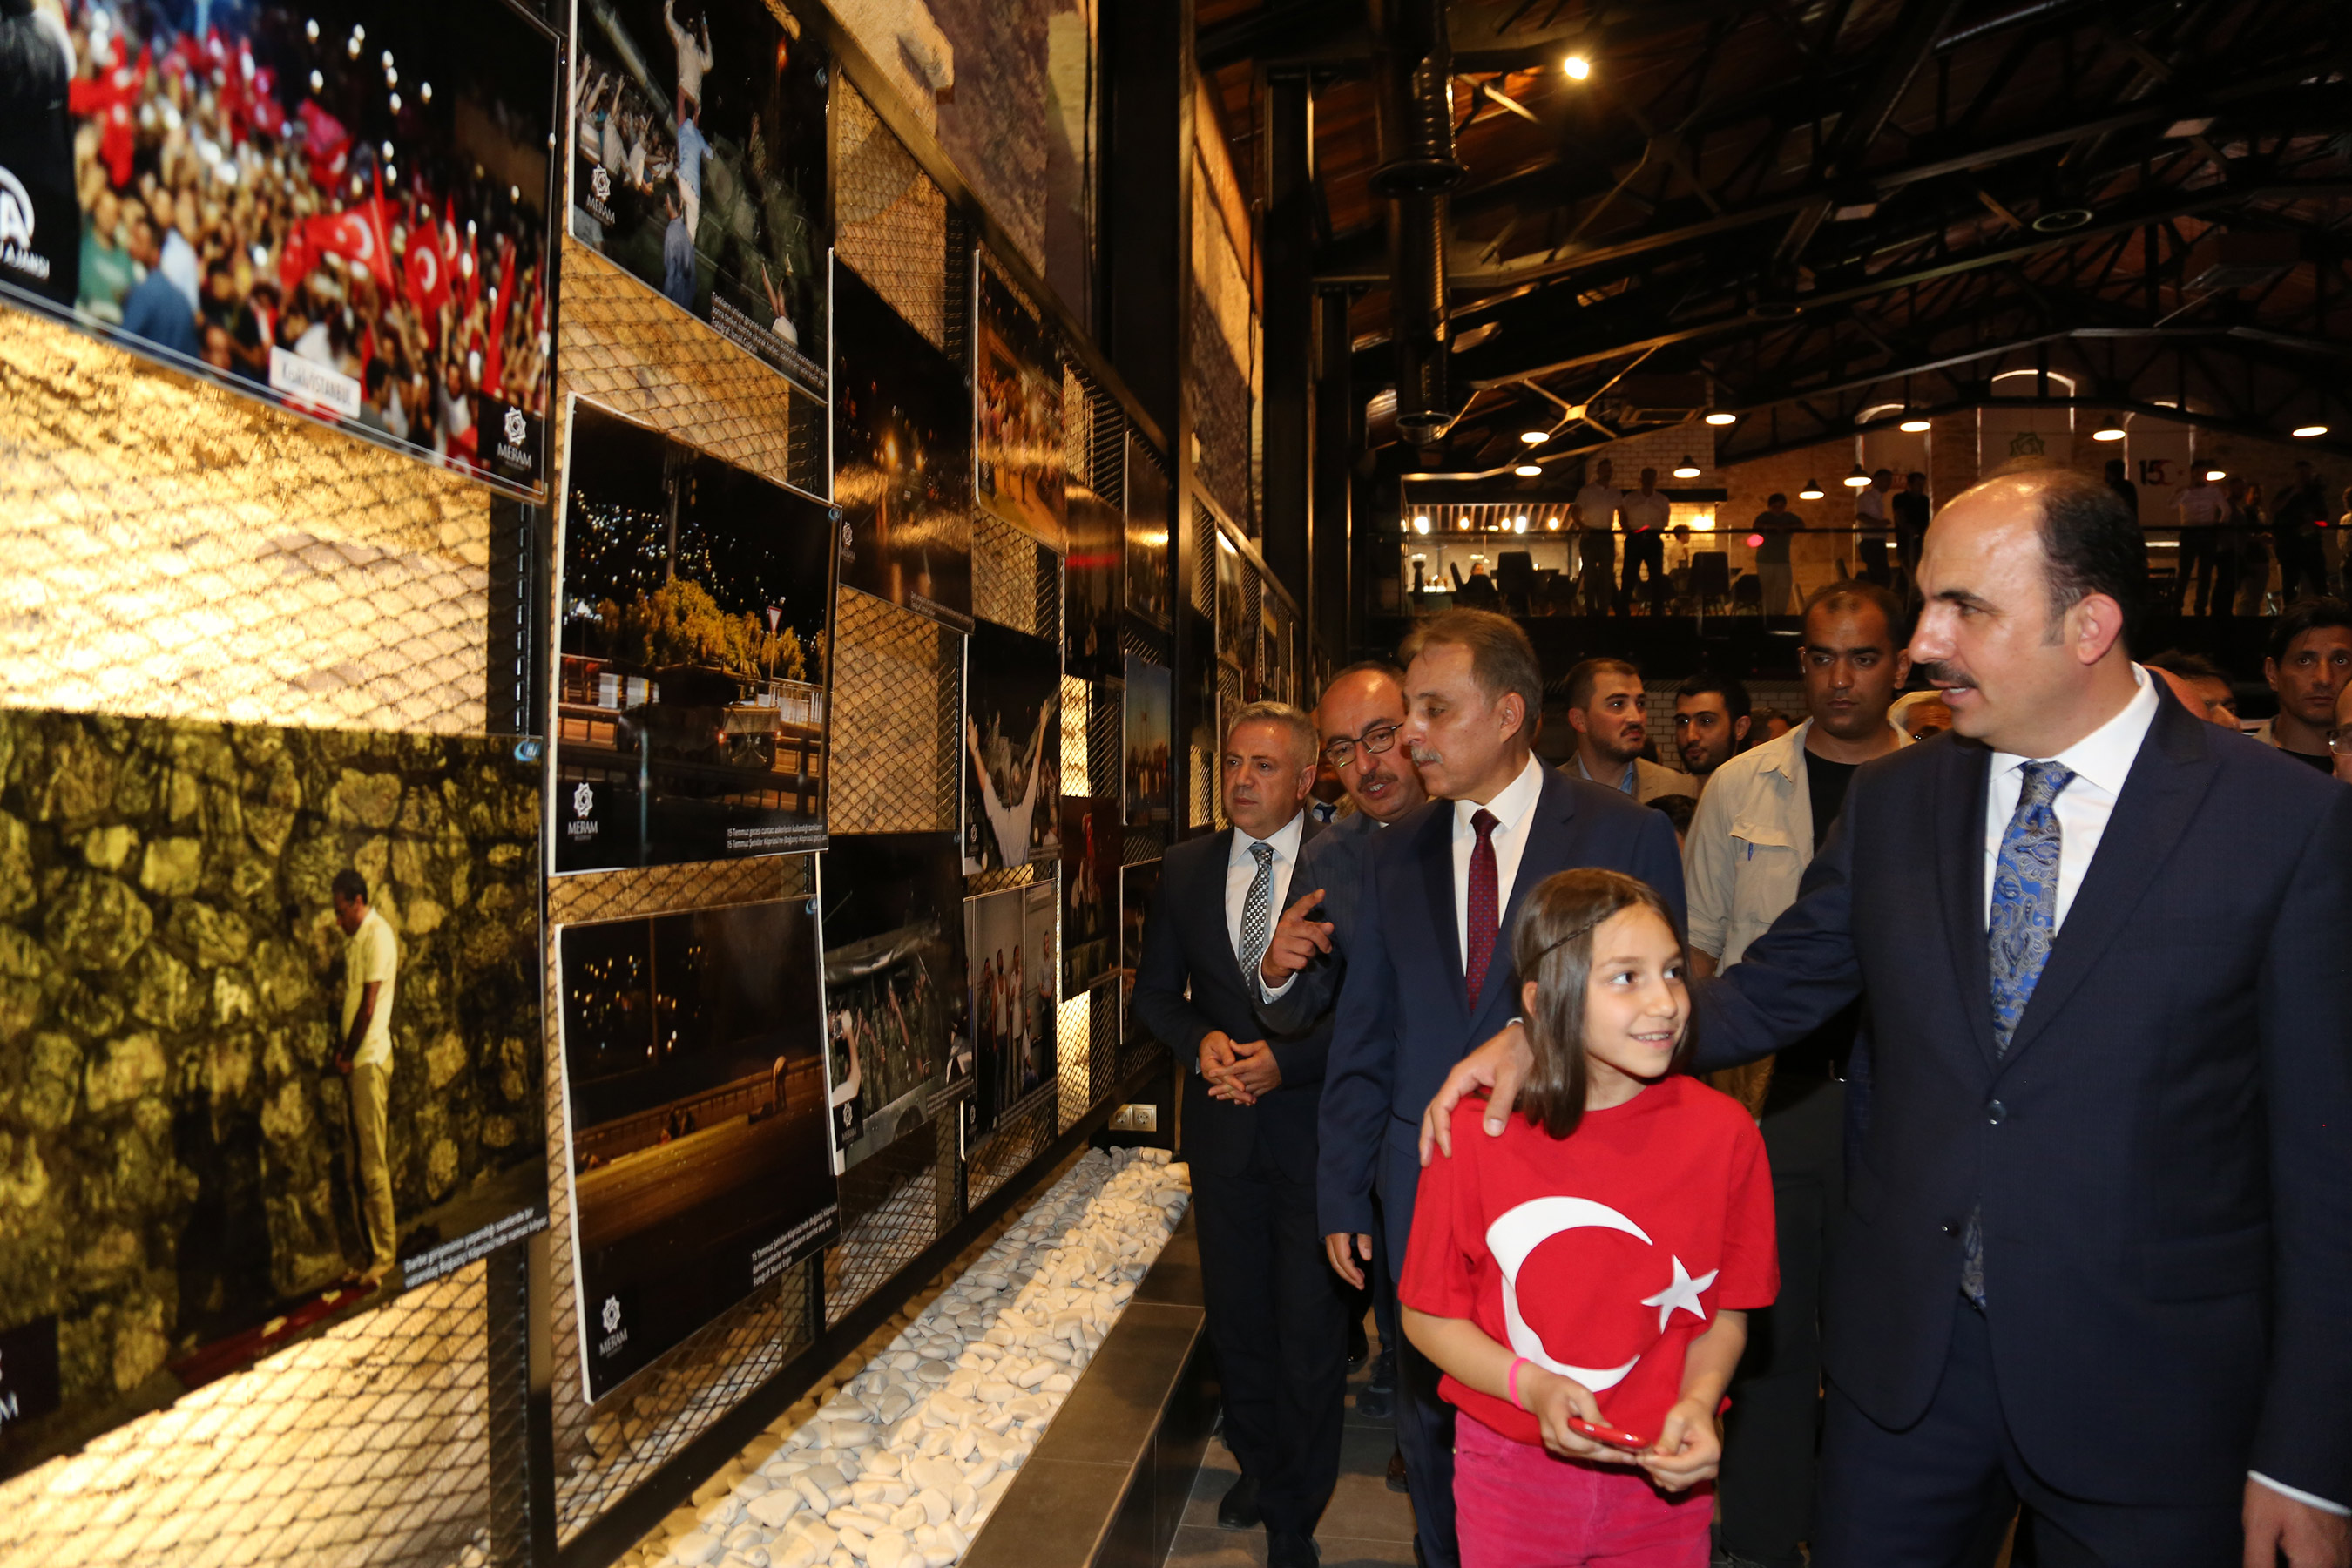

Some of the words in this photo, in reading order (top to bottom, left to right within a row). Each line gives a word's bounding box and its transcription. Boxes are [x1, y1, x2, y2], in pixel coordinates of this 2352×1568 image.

[585, 193, 616, 225] MERAM
[497, 442, 532, 469] MERAM
[568, 820, 598, 835] MERAM
[733, 828, 749, 837] Temmuz
[733, 839, 749, 848] Temmuz
[757, 1243, 774, 1259] Temmuz
[598, 1327, 628, 1356] MERAM
